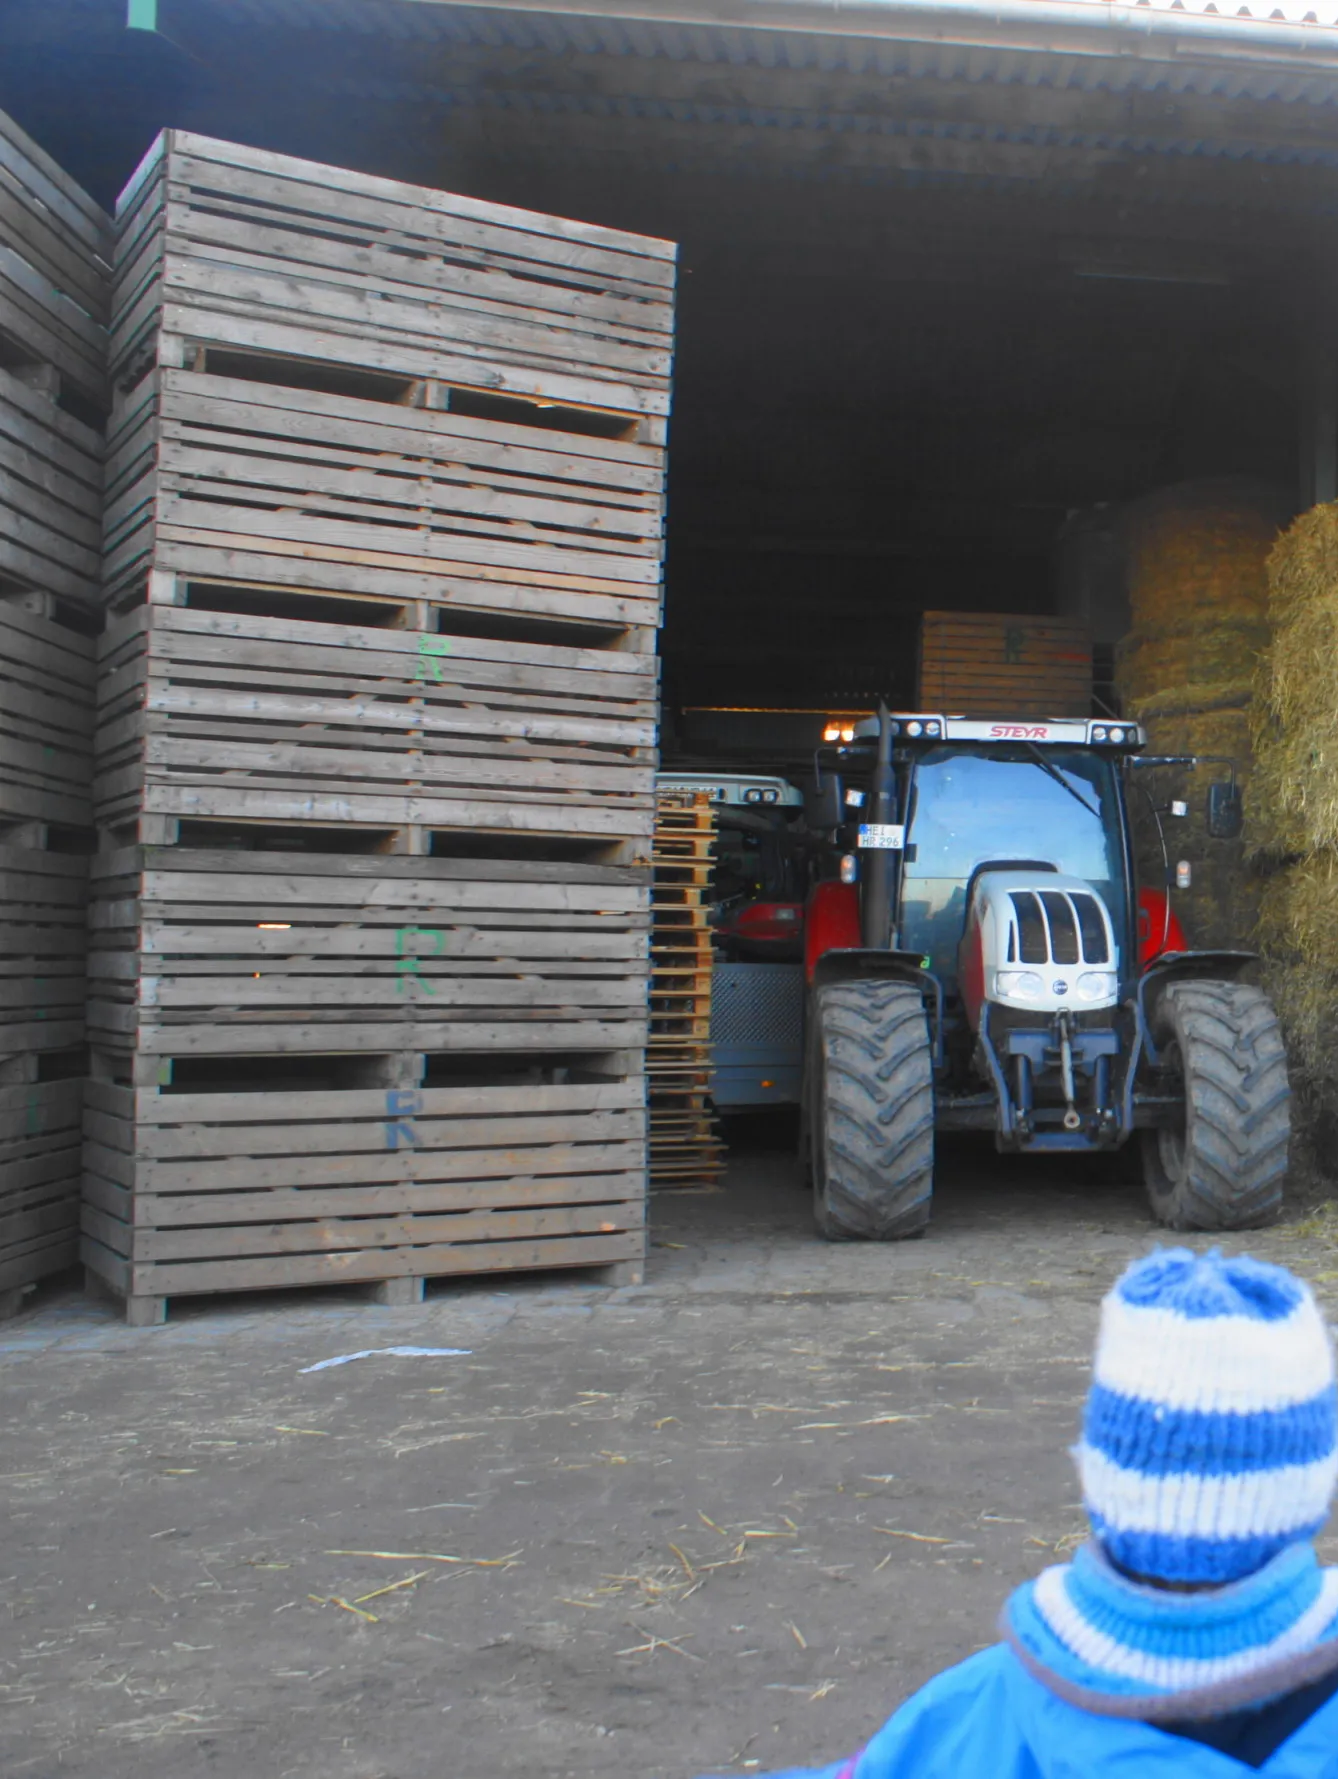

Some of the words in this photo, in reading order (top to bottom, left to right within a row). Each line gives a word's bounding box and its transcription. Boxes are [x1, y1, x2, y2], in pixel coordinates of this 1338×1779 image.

[416, 633, 451, 681] R
[989, 725, 1048, 739] STEYR
[867, 825, 885, 836] HEI
[879, 836, 900, 848] 296
[395, 928, 445, 995] R
[386, 1090, 424, 1149] R
